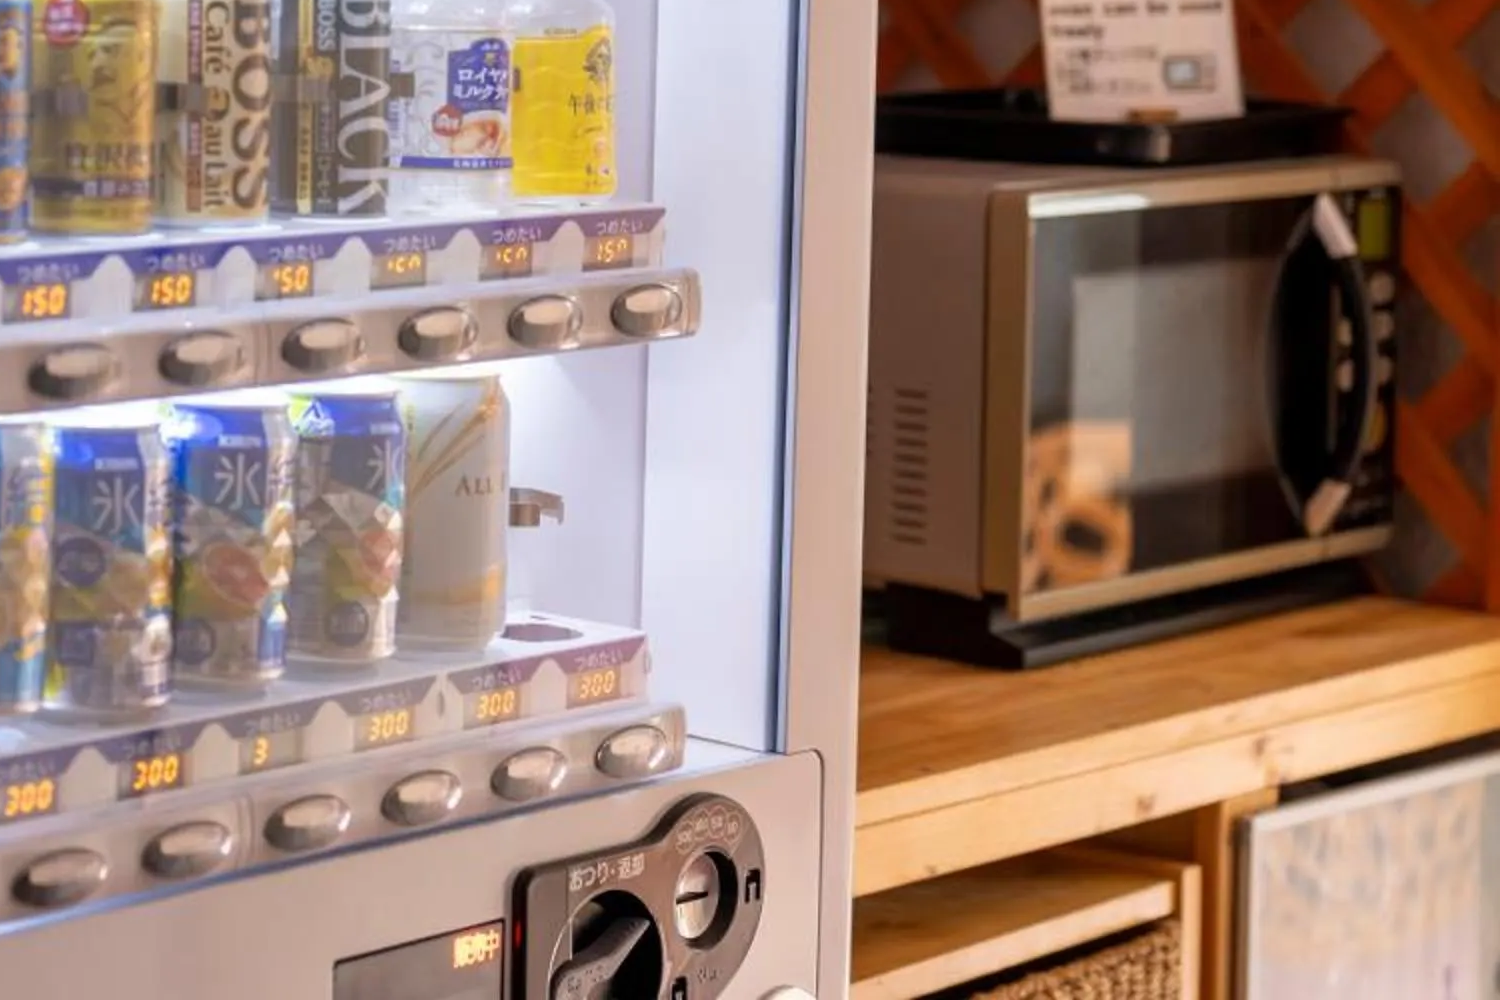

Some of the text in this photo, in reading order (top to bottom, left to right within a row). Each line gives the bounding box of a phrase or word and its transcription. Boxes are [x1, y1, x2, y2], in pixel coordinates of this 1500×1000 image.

[204, 1, 233, 74] Café
[493, 227, 542, 245] つめたい
[596, 219, 643, 235] つめたい
[384, 235, 436, 254] つめたい
[24, 285, 65, 315] 150
[152, 276, 191, 303] 150
[213, 450, 261, 510] 氷
[94, 477, 140, 534] 氷
[580, 671, 615, 698] 300
[478, 691, 515, 718] 300
[370, 712, 409, 740] 300
[134, 756, 178, 789] 300
[6, 780, 53, 815] 300
